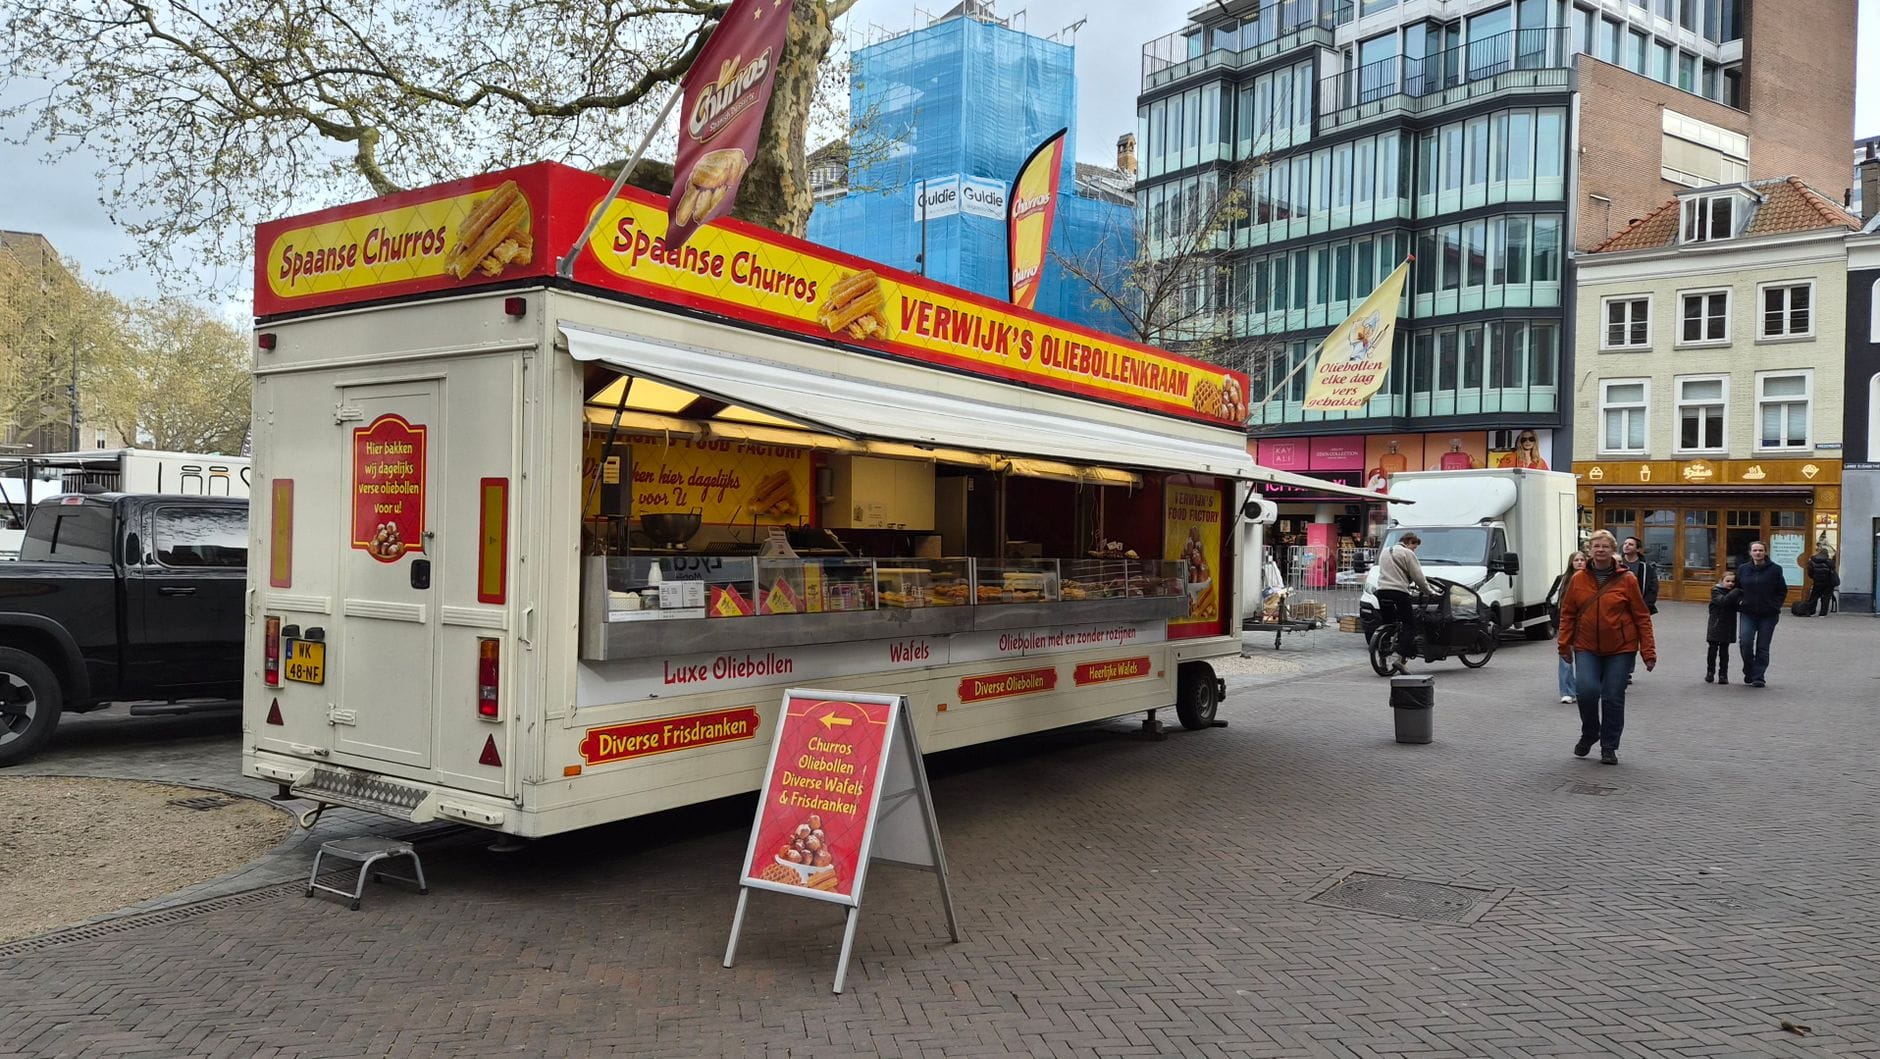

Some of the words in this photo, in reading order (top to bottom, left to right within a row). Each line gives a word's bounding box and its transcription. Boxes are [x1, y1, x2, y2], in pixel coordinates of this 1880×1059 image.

[690, 53, 769, 134] Churros
[917, 188, 956, 208] Guldie
[963, 186, 1004, 207] Guldie
[279, 241, 356, 288] Spaanse
[362, 225, 447, 266] Churros
[613, 216, 724, 278] Spaanse
[731, 250, 817, 305] Churros
[900, 295, 1034, 363] VERWIJK'S
[1039, 333, 1190, 399] OLIEBOLLENKRAAM
[1320, 360, 1383, 374] Oliebollen
[1321, 374, 1348, 385] elke
[1349, 373, 1376, 385] dag
[1306, 396, 1363, 408] gebakke
[1332, 387, 1359, 396] vers
[366, 441, 383, 455] Hier
[384, 440, 413, 455] bakken
[364, 462, 377, 479] wij
[378, 460, 414, 479] dagelijks
[358, 483, 380, 495] verse
[380, 480, 419, 495] oliebollen
[658, 463, 685, 486] hier
[687, 465, 741, 504] dagelijks
[373, 503, 393, 514] voor
[393, 500, 402, 514] u!
[638, 492, 670, 506] voor
[672, 486, 688, 507] U
[1167, 506, 1187, 521] FOOD
[1189, 508, 1219, 523] FACTORY
[999, 632, 1046, 652] Oliebollen
[1048, 630, 1064, 648] met
[1066, 634, 1076, 645] en
[1077, 627, 1105, 644] zonder
[1106, 625, 1137, 645] rozijnen
[298, 642, 312, 659] WK
[889, 639, 930, 663] Wafels
[289, 663, 320, 681] 48-NF
[663, 660, 708, 685] Luxe
[712, 652, 793, 680] Oliebollen
[1089, 665, 1117, 681] Heerlijke
[1118, 661, 1138, 676] Wafels
[974, 677, 1005, 696] Diverse
[1006, 673, 1044, 692] Oliebollen
[599, 733, 659, 757] Diverse
[663, 717, 748, 746] Frisdranken
[807, 736, 853, 755] Churros
[798, 754, 854, 775] Oliebollen
[781, 770, 823, 790] Diverse
[823, 777, 864, 796] Wafels
[778, 789, 788, 805] &
[790, 791, 857, 816] Frisdranken
